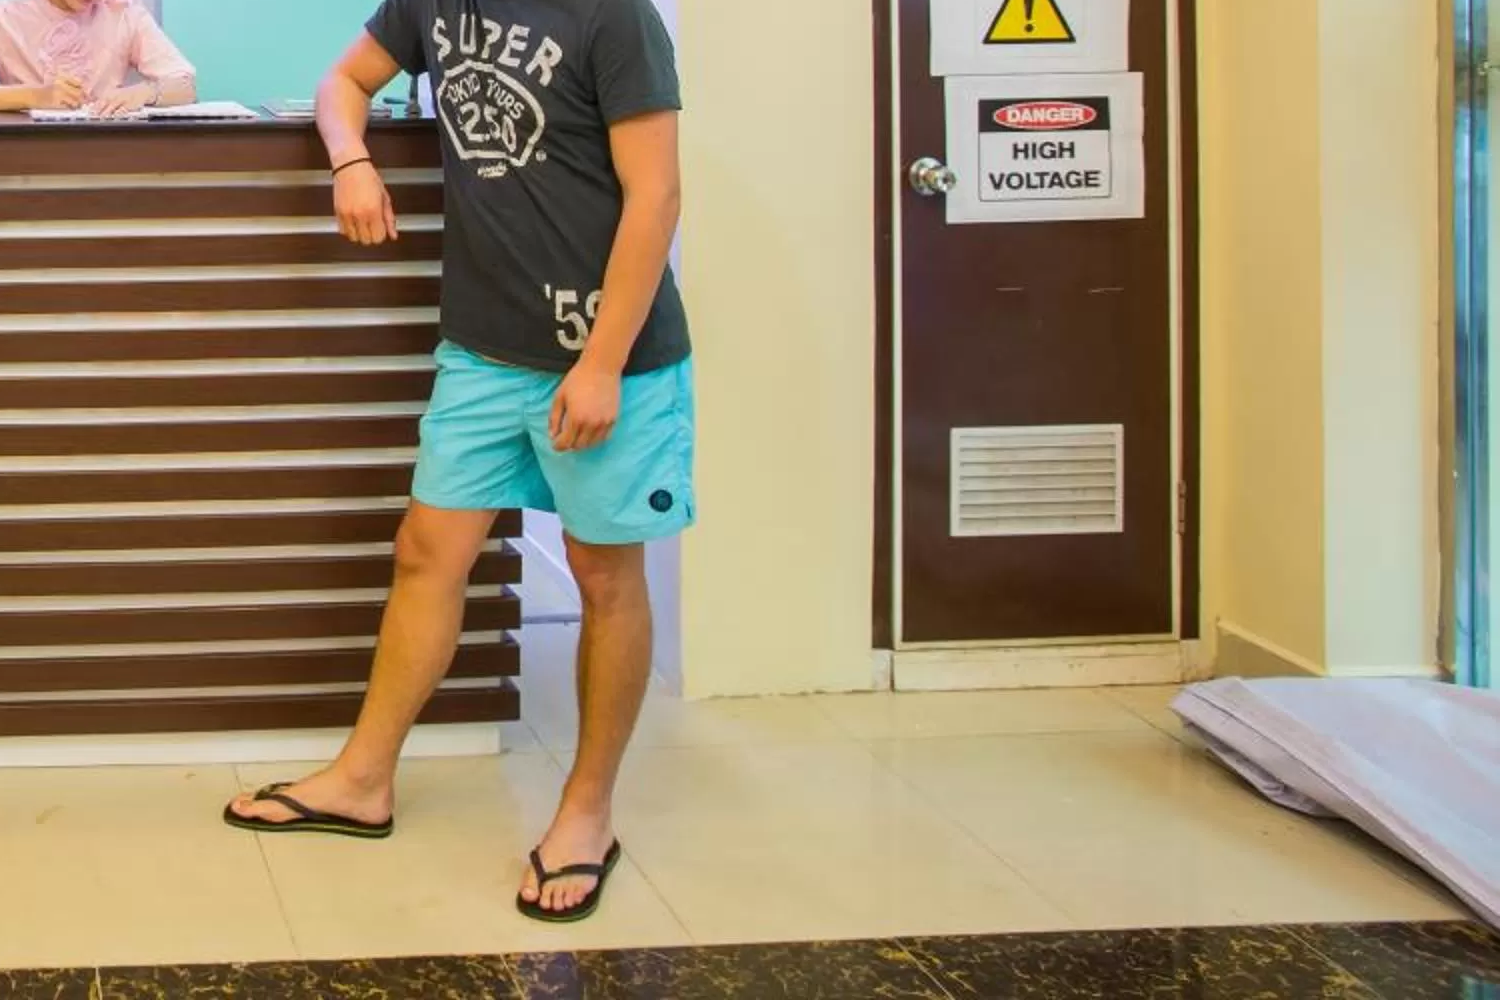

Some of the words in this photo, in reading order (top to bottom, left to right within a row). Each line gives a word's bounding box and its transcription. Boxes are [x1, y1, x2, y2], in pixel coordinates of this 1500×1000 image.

[431, 13, 563, 87] SUPER
[1007, 107, 1084, 122] DANGER
[1012, 141, 1075, 160] HIGH
[988, 170, 1102, 190] VOLTAGE
